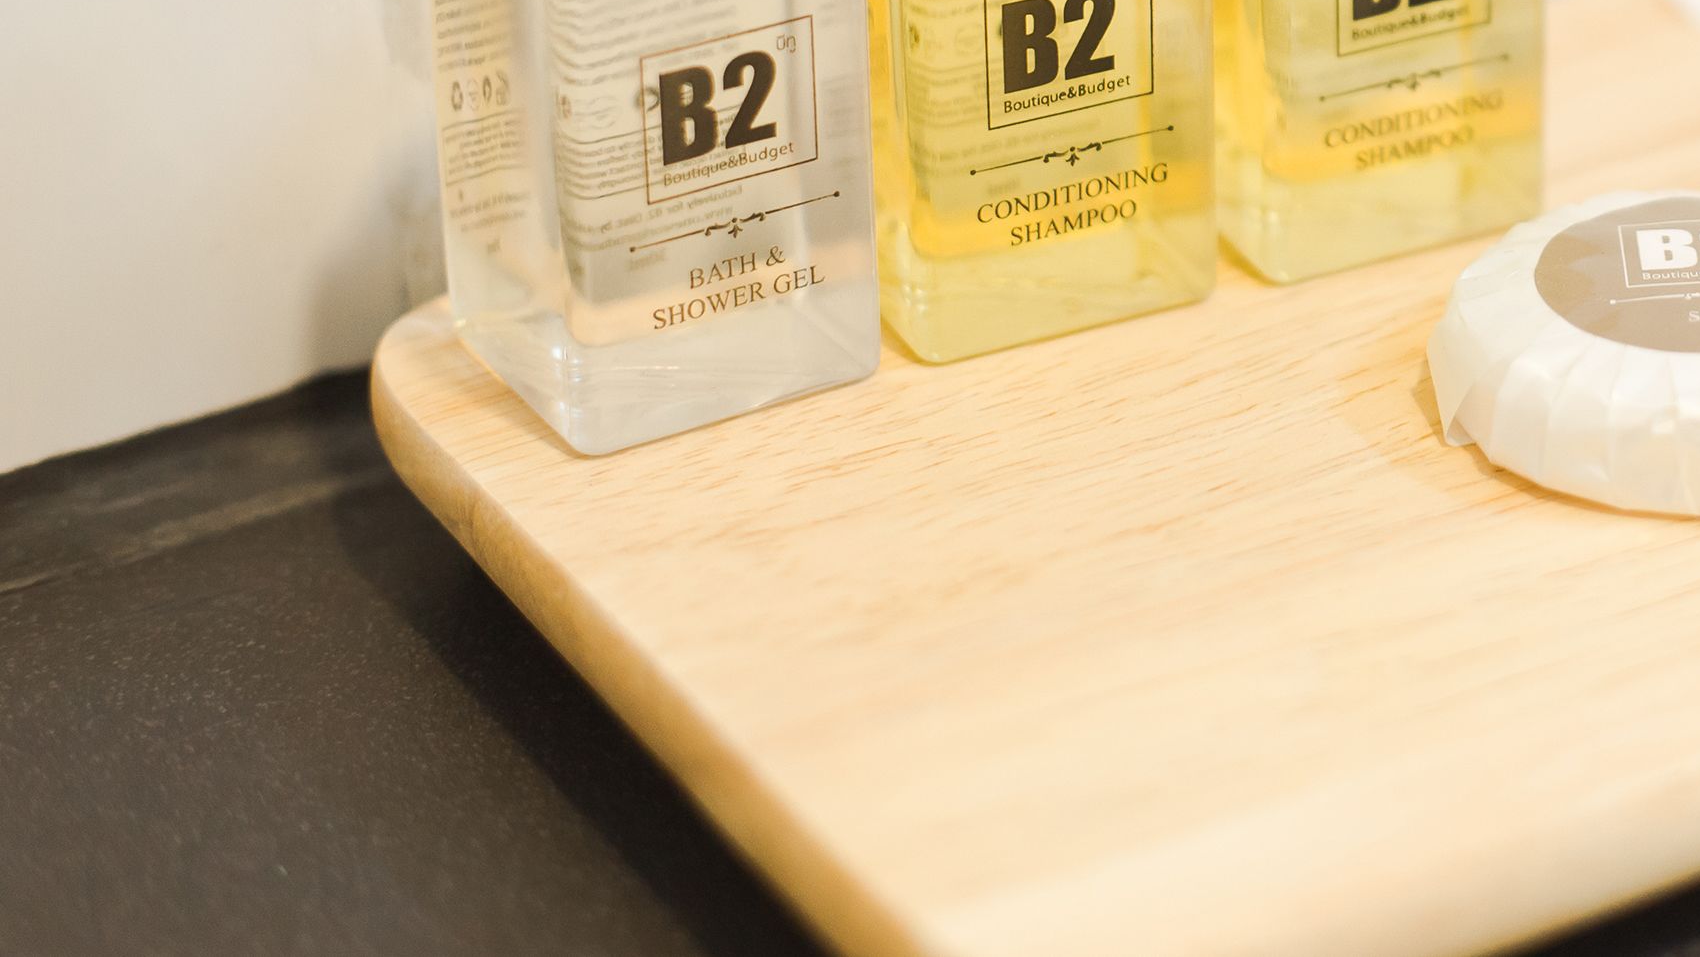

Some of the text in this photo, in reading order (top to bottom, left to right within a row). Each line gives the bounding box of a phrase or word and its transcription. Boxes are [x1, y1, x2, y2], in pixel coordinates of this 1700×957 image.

[659, 51, 777, 166] B2
[1003, 75, 1131, 114] Boutique&Budget
[1325, 88, 1505, 148] CONDITIONING
[663, 142, 795, 186] Boutique&Budget
[1355, 124, 1475, 171] SHAMPOO
[977, 162, 1169, 224] CONDITIONING
[1011, 199, 1138, 247] SHAMPOO
[690, 252, 757, 289] BATH
[765, 245, 786, 267] &
[652, 264, 826, 330] SHOWER GEL
